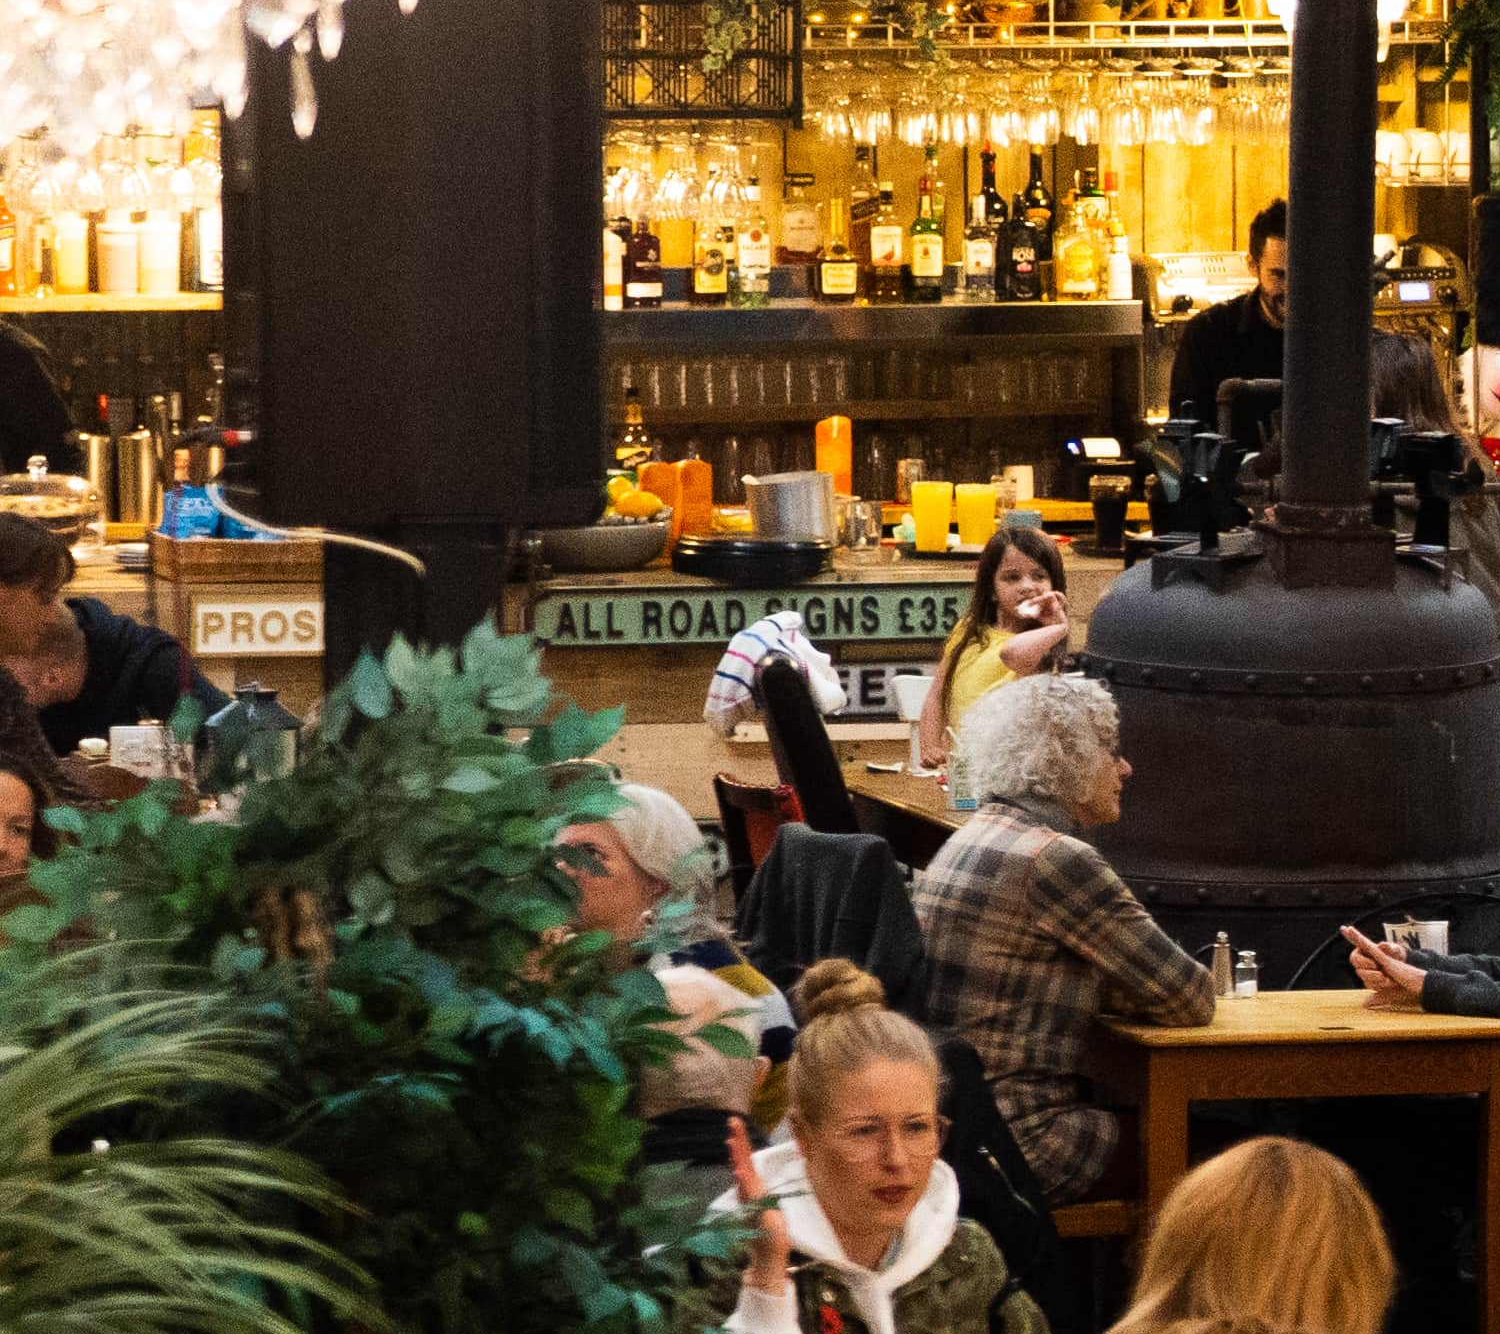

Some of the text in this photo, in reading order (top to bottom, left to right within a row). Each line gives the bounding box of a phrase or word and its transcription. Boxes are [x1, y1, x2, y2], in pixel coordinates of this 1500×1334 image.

[557, 600, 626, 640] ALL
[642, 599, 747, 638] ROAD
[898, 595, 960, 634] £35
